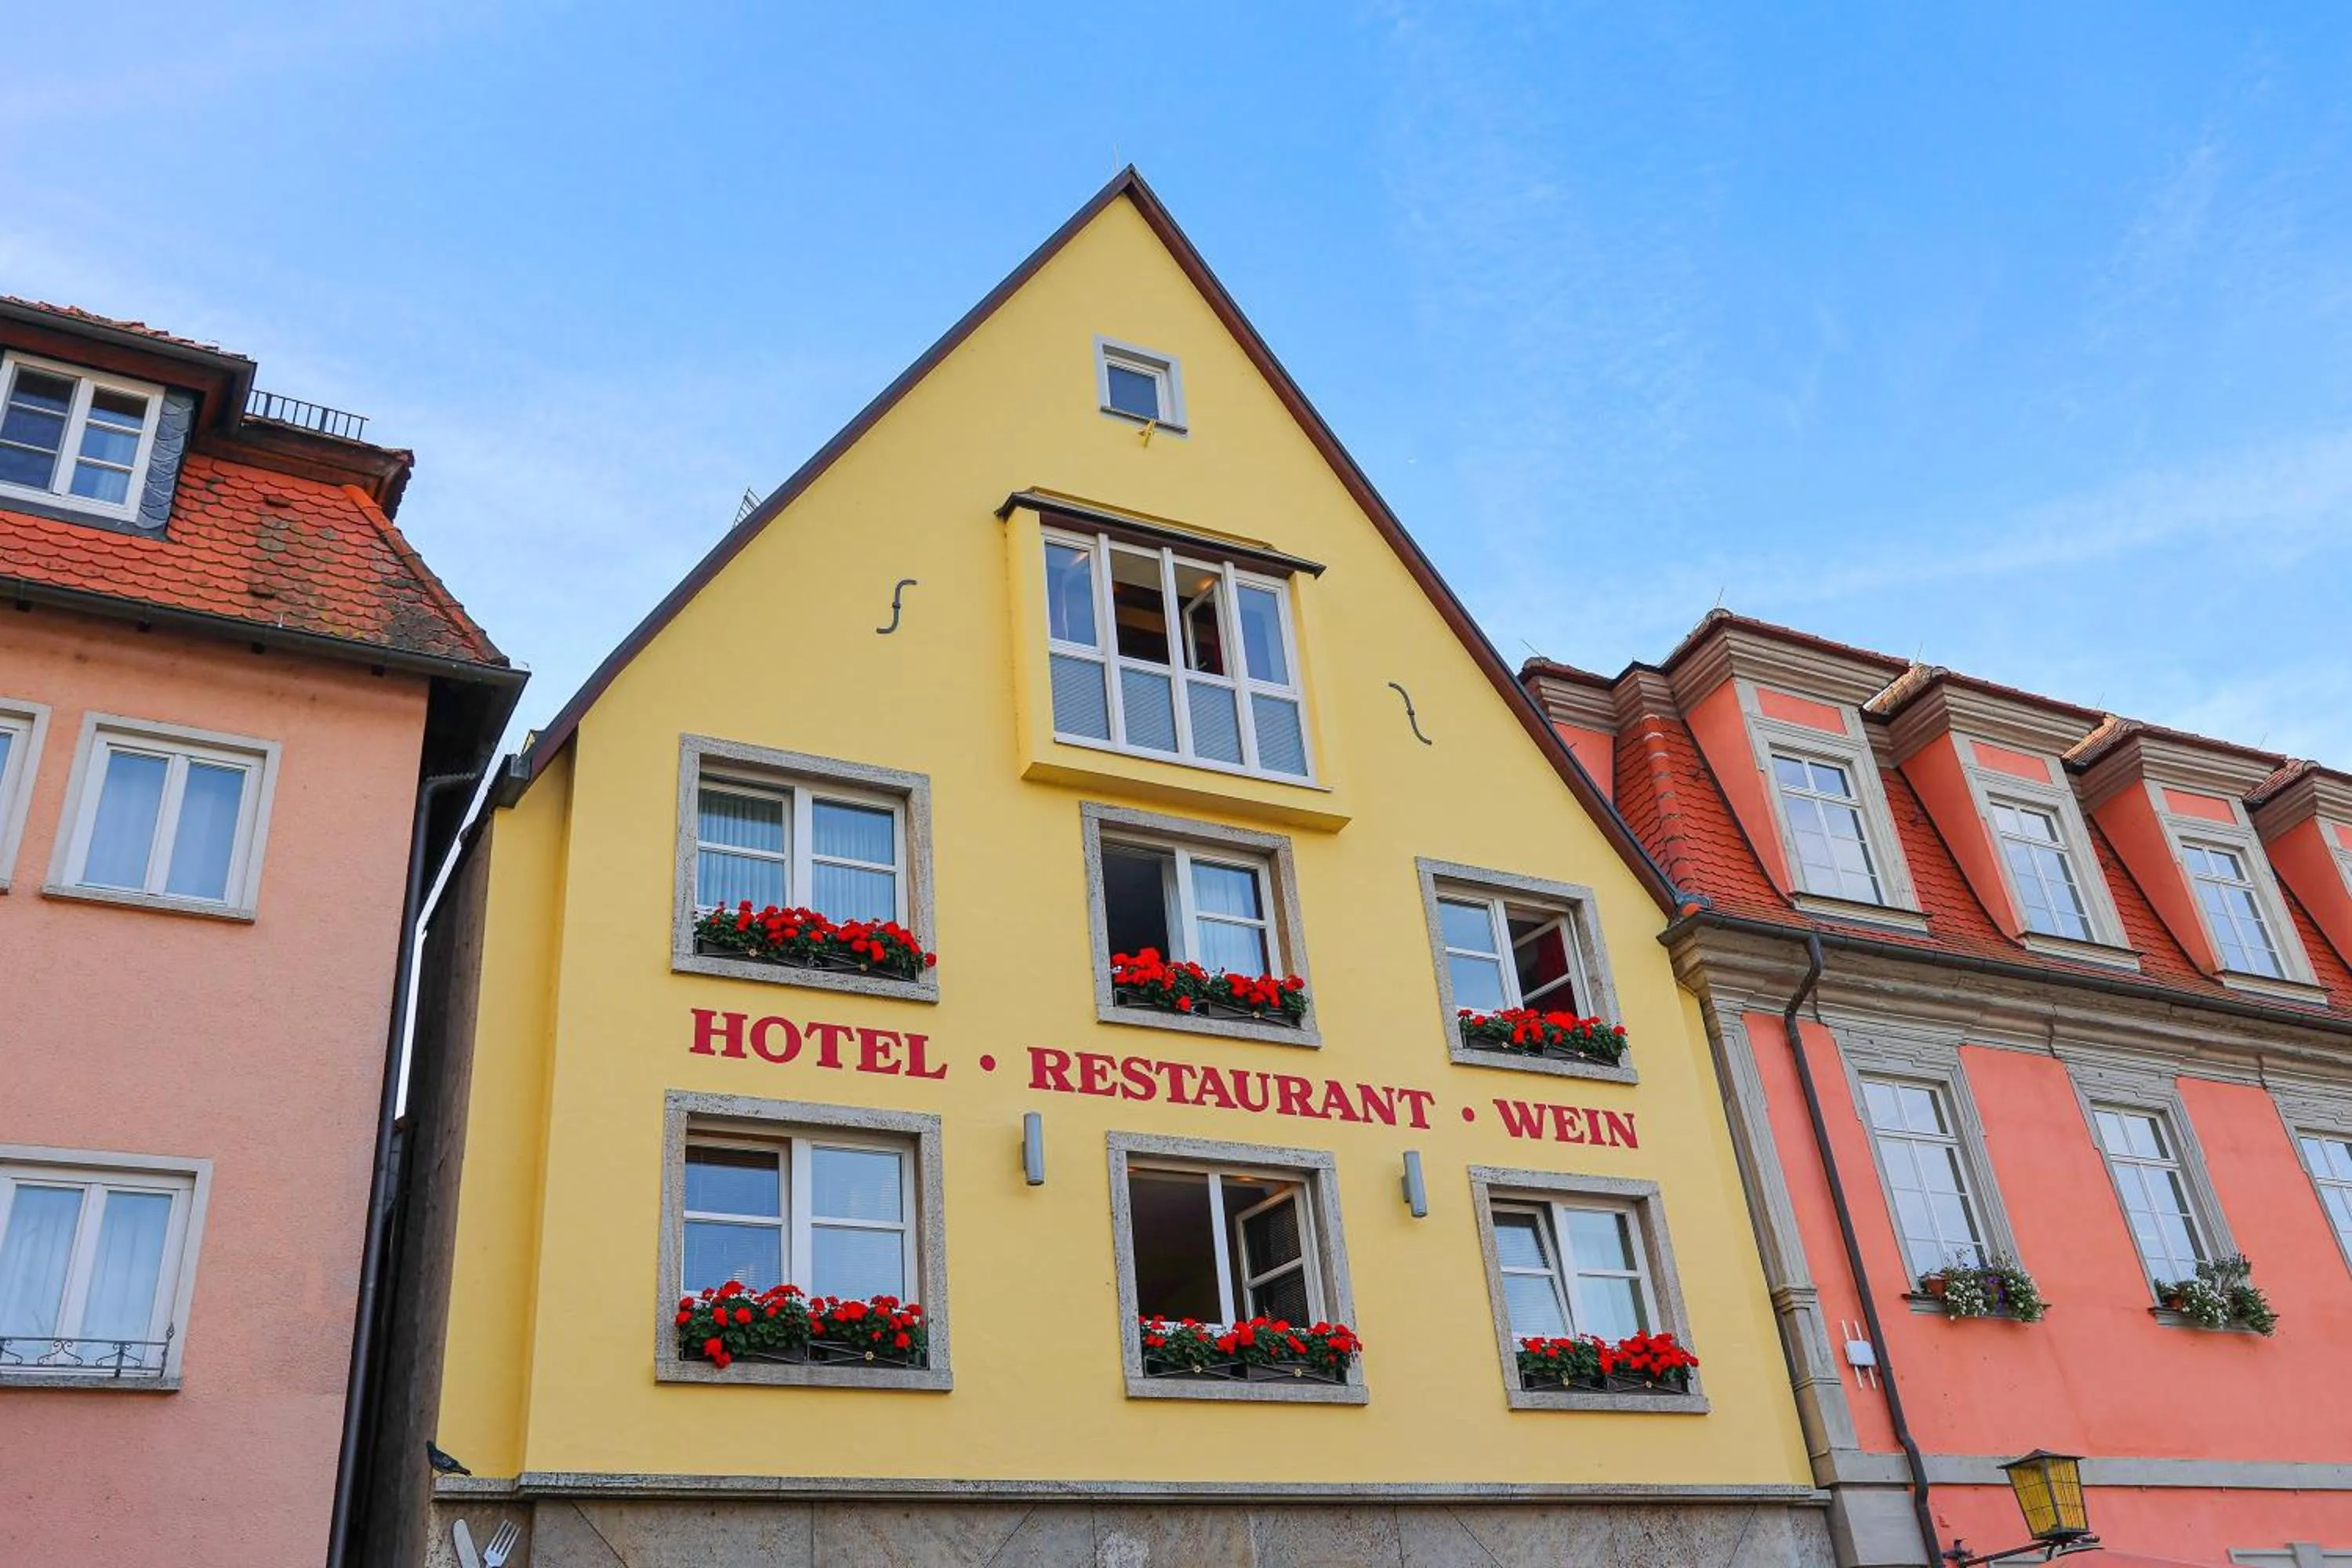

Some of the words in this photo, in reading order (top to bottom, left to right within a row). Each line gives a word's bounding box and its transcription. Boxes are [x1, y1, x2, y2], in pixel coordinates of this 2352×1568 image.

[689, 1008, 948, 1080] HOTEL
[1028, 1047, 1435, 1130] RESTAURANT
[1494, 1098, 1639, 1149] WEIN
